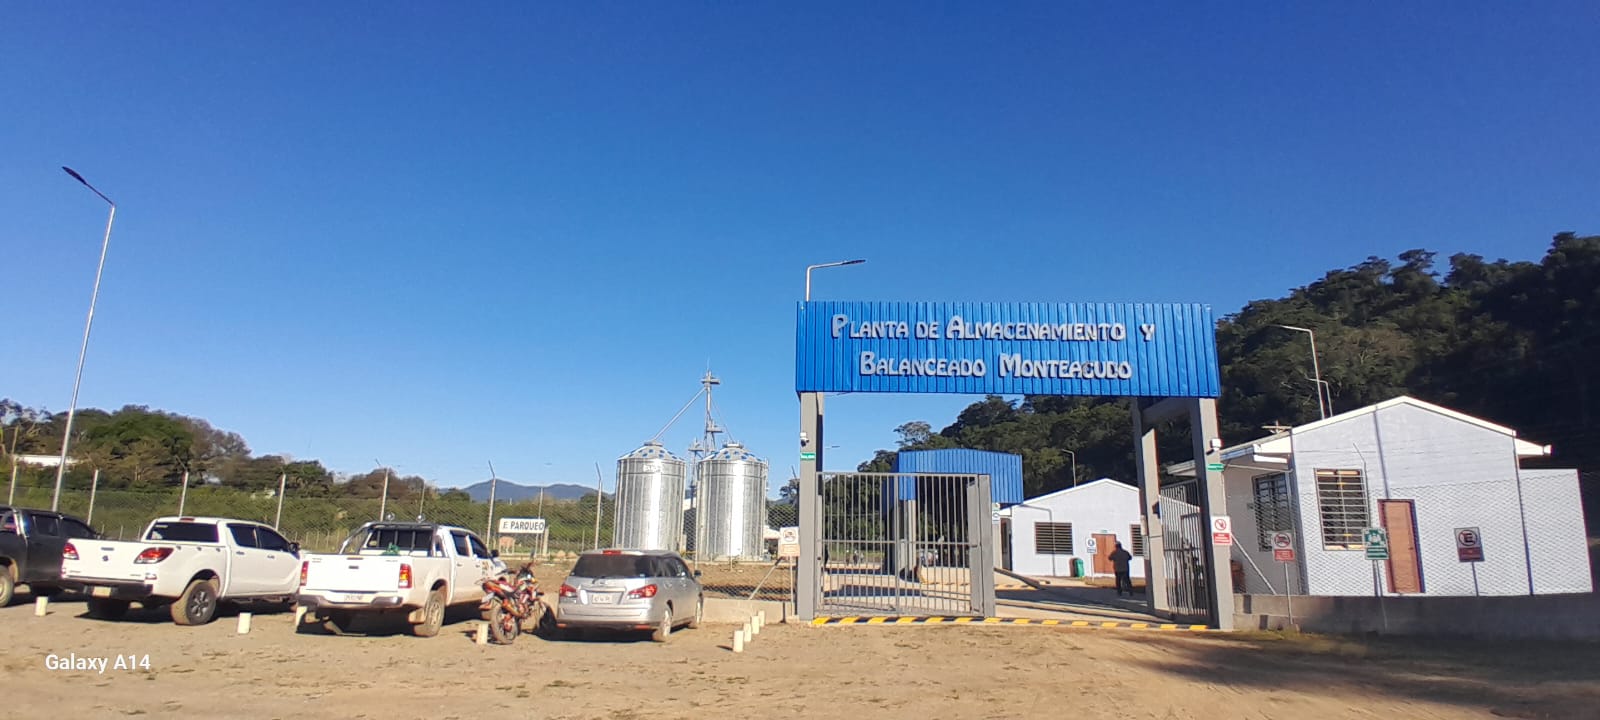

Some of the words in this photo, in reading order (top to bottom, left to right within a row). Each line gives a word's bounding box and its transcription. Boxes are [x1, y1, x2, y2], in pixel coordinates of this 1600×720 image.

[831, 313, 909, 339] PLANTA
[915, 321, 940, 339] DE
[945, 315, 1126, 341] ALMACENAMIENTO
[1139, 323, 1155, 341] Y
[860, 350, 986, 377] BALANCEADO
[999, 353, 1132, 379] MONTEAGUDO
[511, 520, 545, 530] PARQUEO
